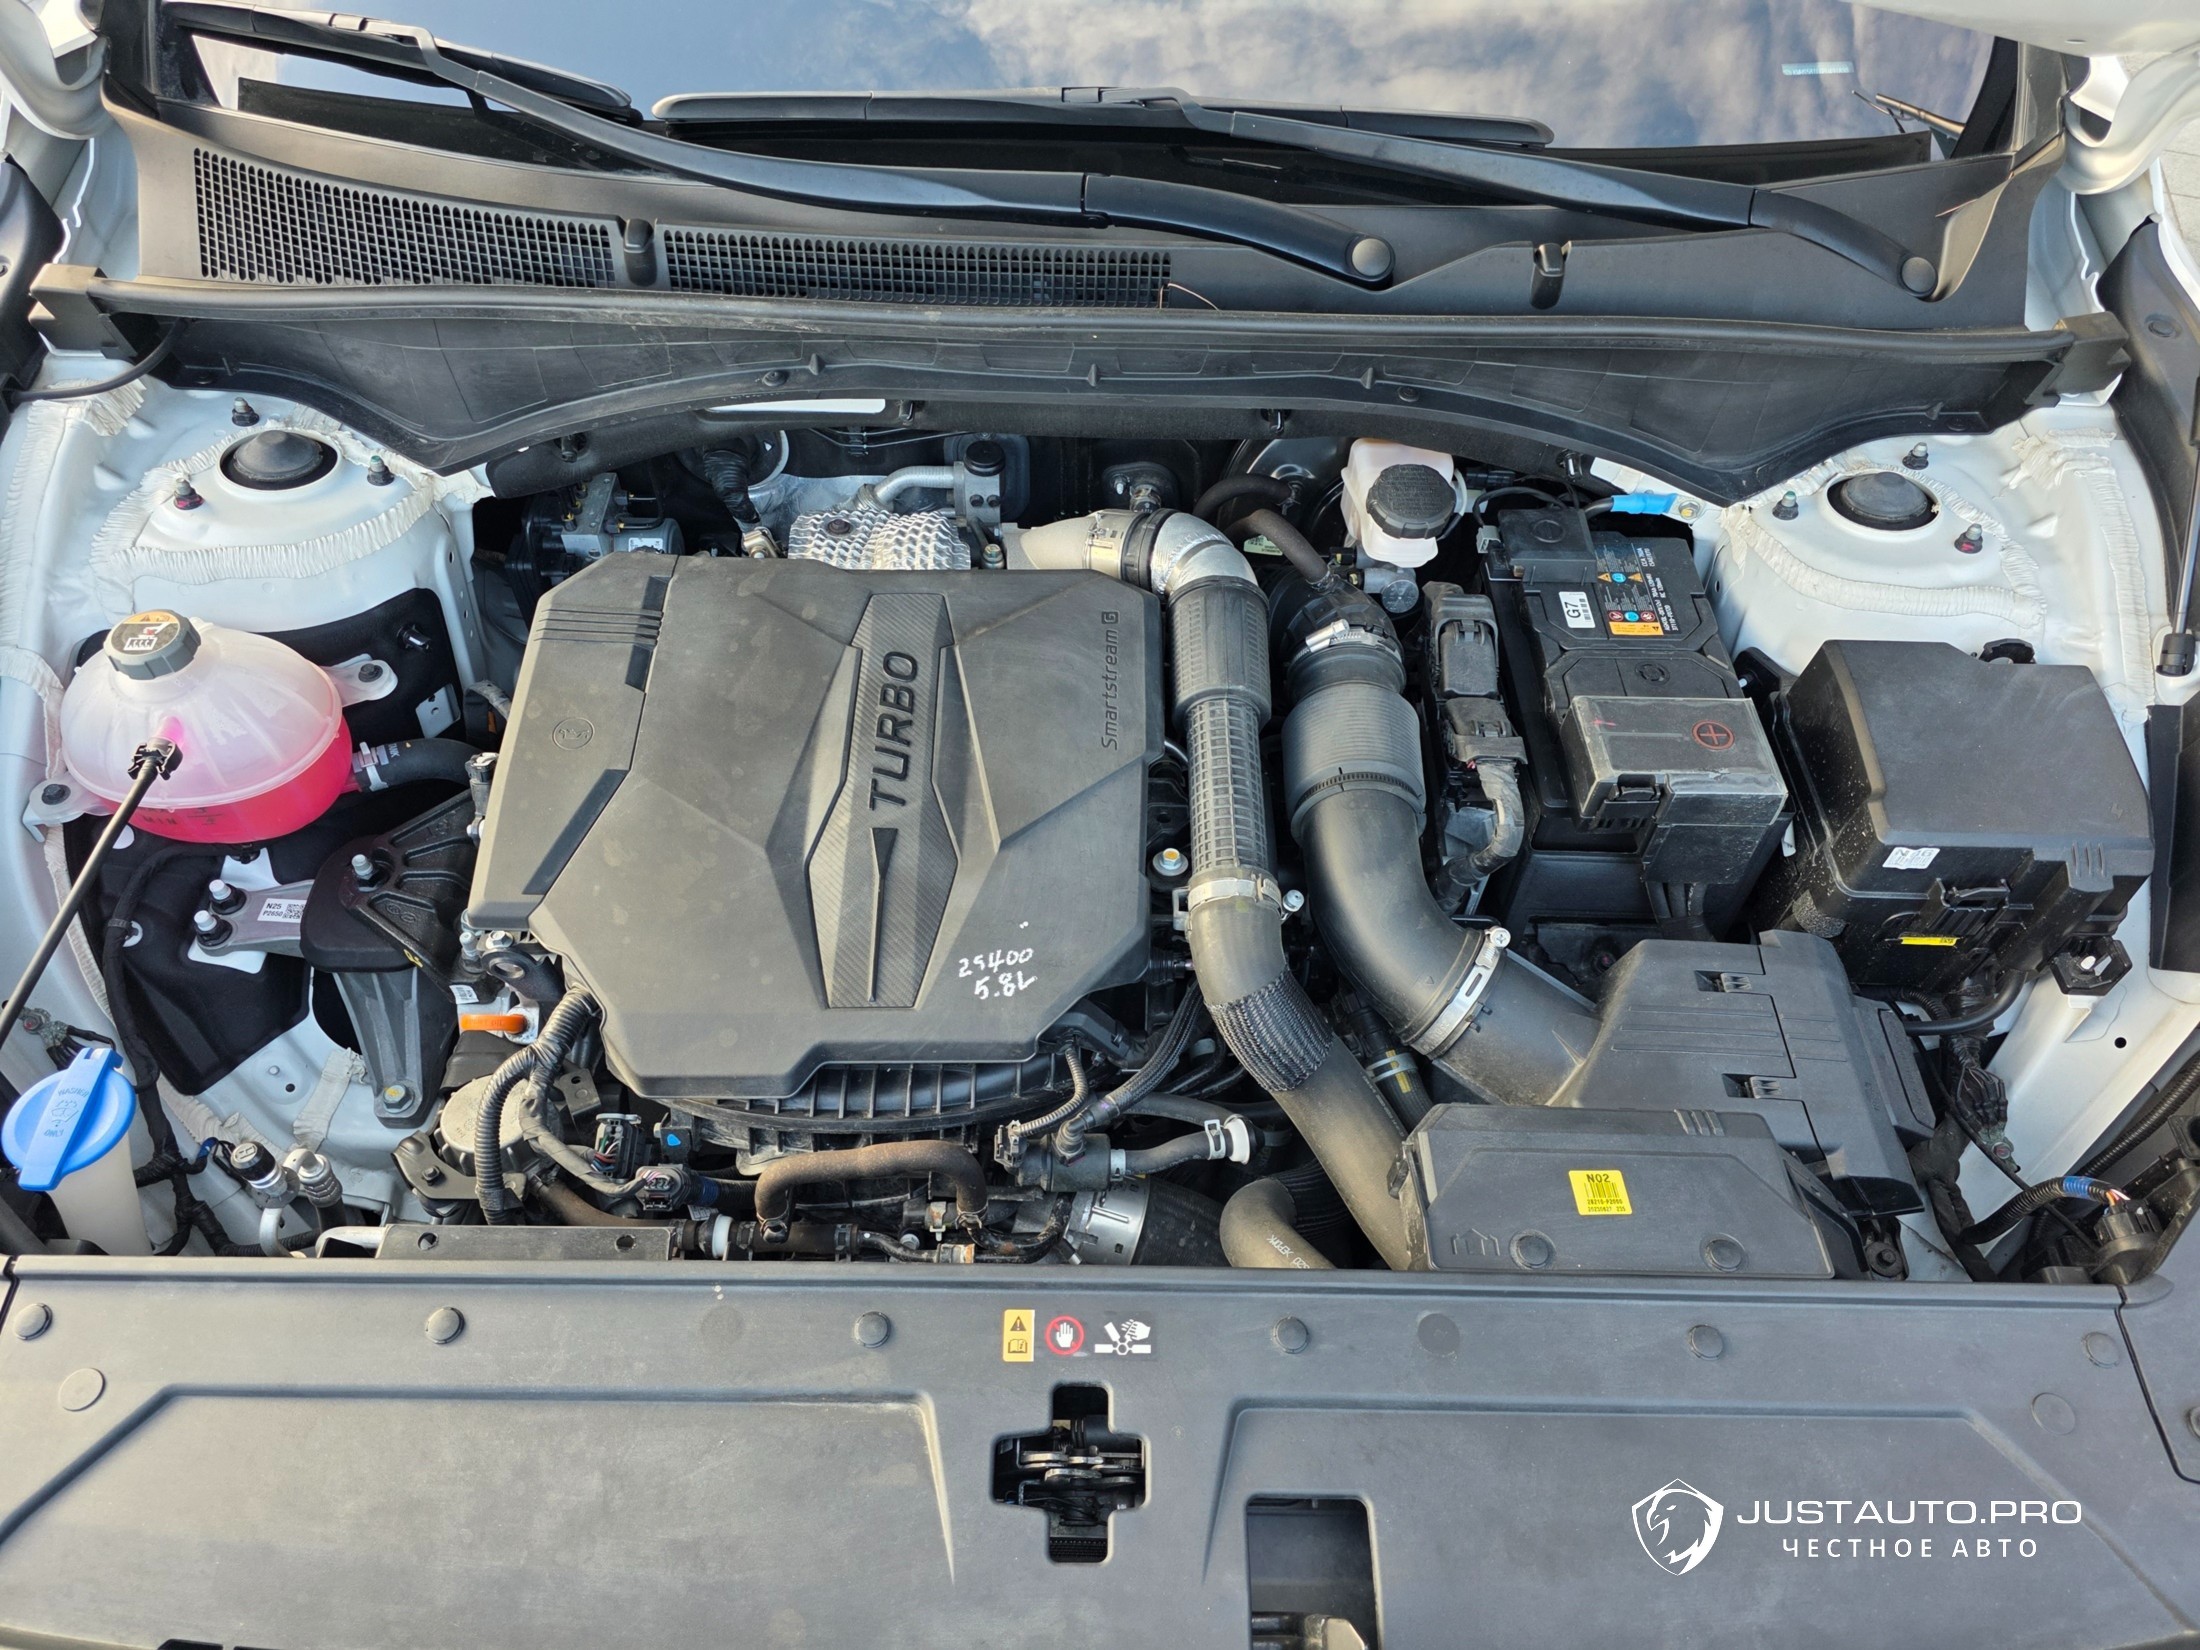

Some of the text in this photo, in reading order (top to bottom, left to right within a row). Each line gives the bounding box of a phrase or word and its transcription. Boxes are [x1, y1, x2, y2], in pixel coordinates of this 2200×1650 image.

[1564, 601, 1581, 618] G7
[1101, 629, 1118, 750] Smartstream
[868, 651, 919, 811] TURBO
[974, 970, 1039, 1000] 5.8L
[43, 1129, 65, 1137] ONLY
